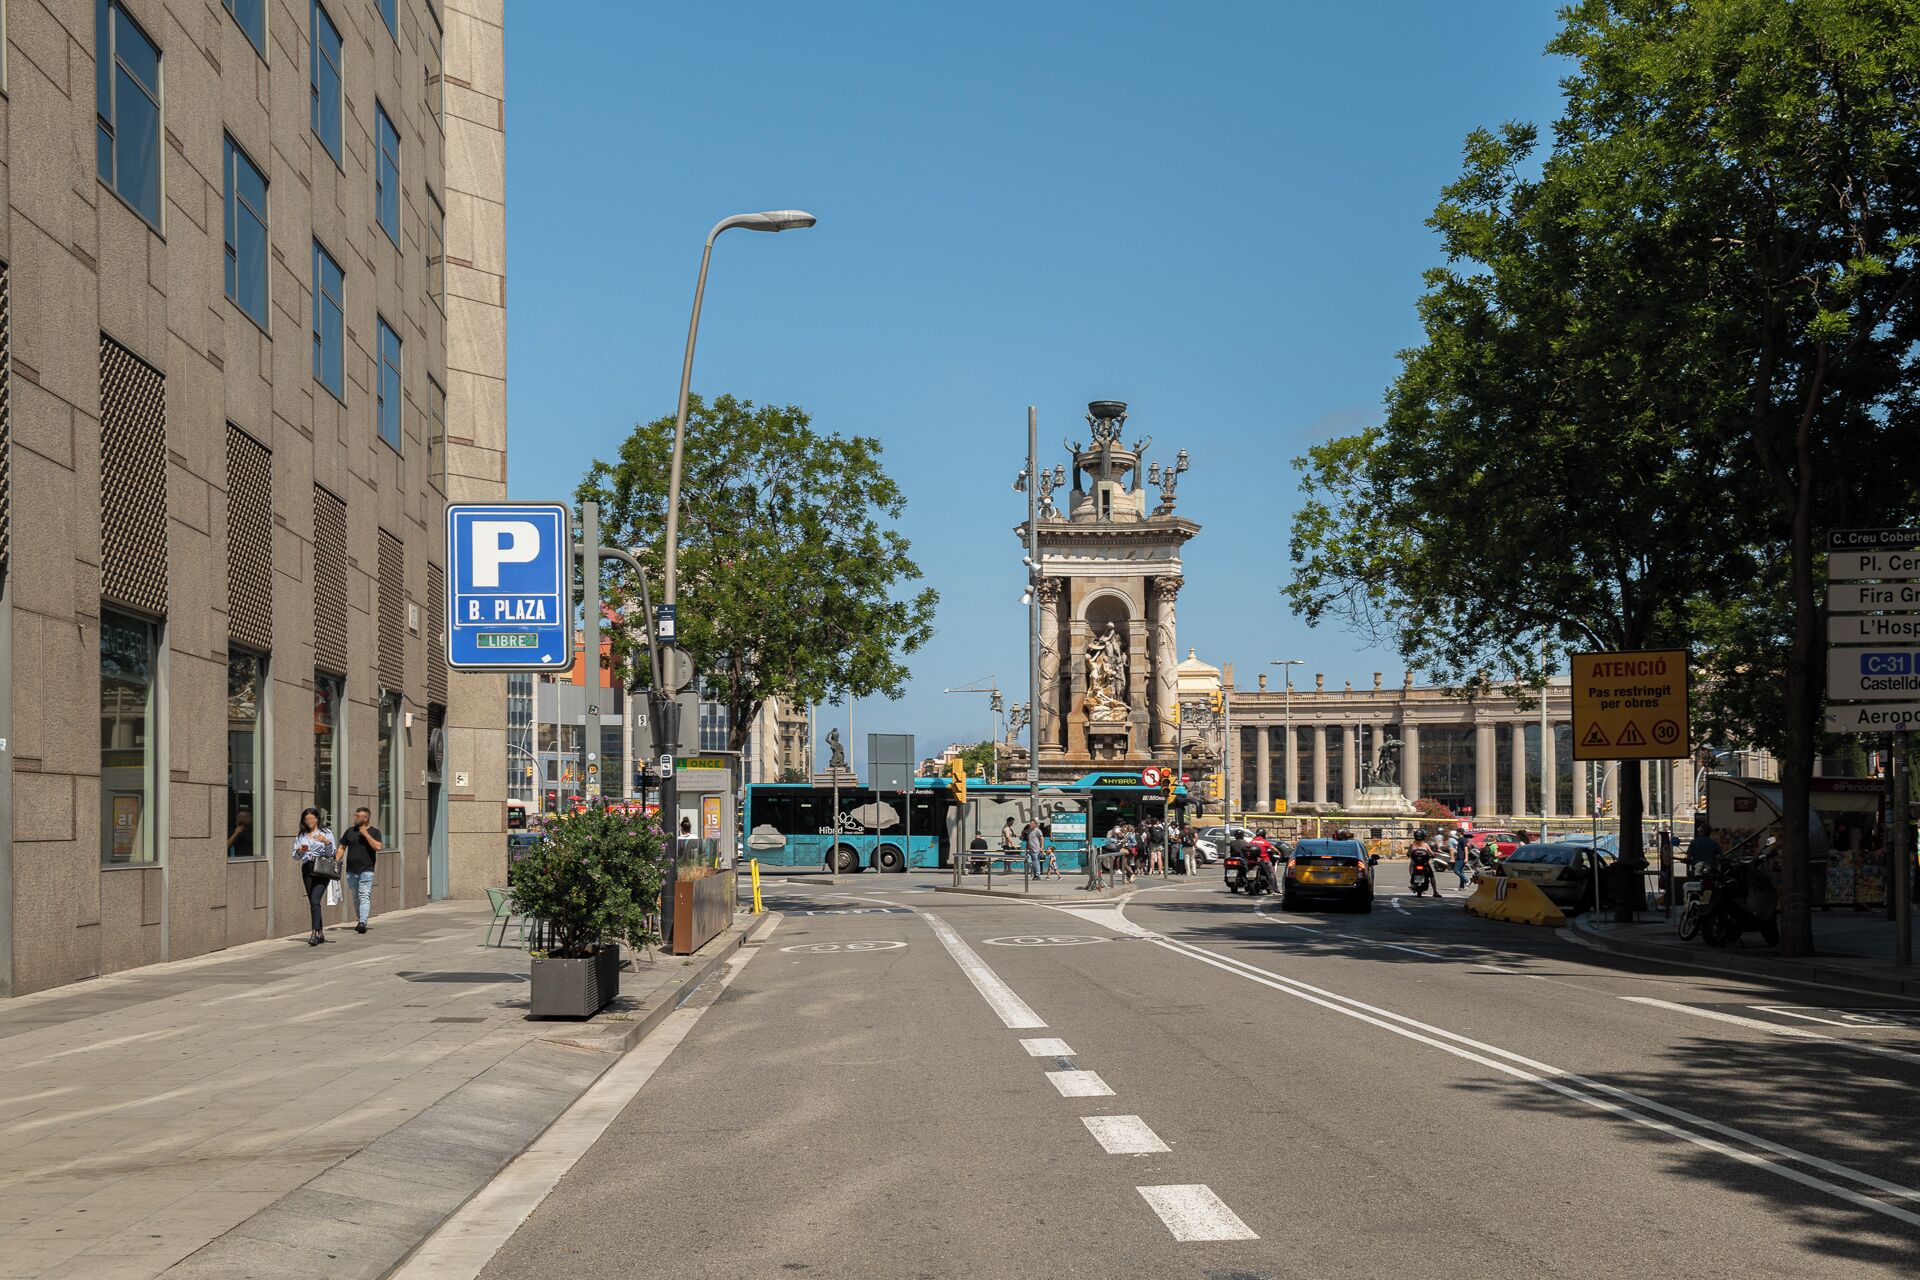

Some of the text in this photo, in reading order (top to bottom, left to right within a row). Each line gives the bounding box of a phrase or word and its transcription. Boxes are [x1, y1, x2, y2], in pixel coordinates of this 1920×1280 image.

[1833, 533, 1846, 545] C.
[1849, 533, 1877, 545] Creu
[472, 521, 540, 587] P
[1860, 556, 1882, 571] Pl.
[1860, 588, 1893, 603] Fira
[469, 599, 546, 620] B. PLAZA
[488, 635, 527, 647] LIBRE
[1592, 657, 1667, 678] ATENCIÓ
[1868, 656, 1904, 672] C-31
[1588, 685, 1671, 698] Pas restringit
[1601, 697, 1659, 711] per obres
[1657, 726, 1674, 739] 30
[691, 760, 721, 768] ONCE
[706, 814, 718, 825] 15
